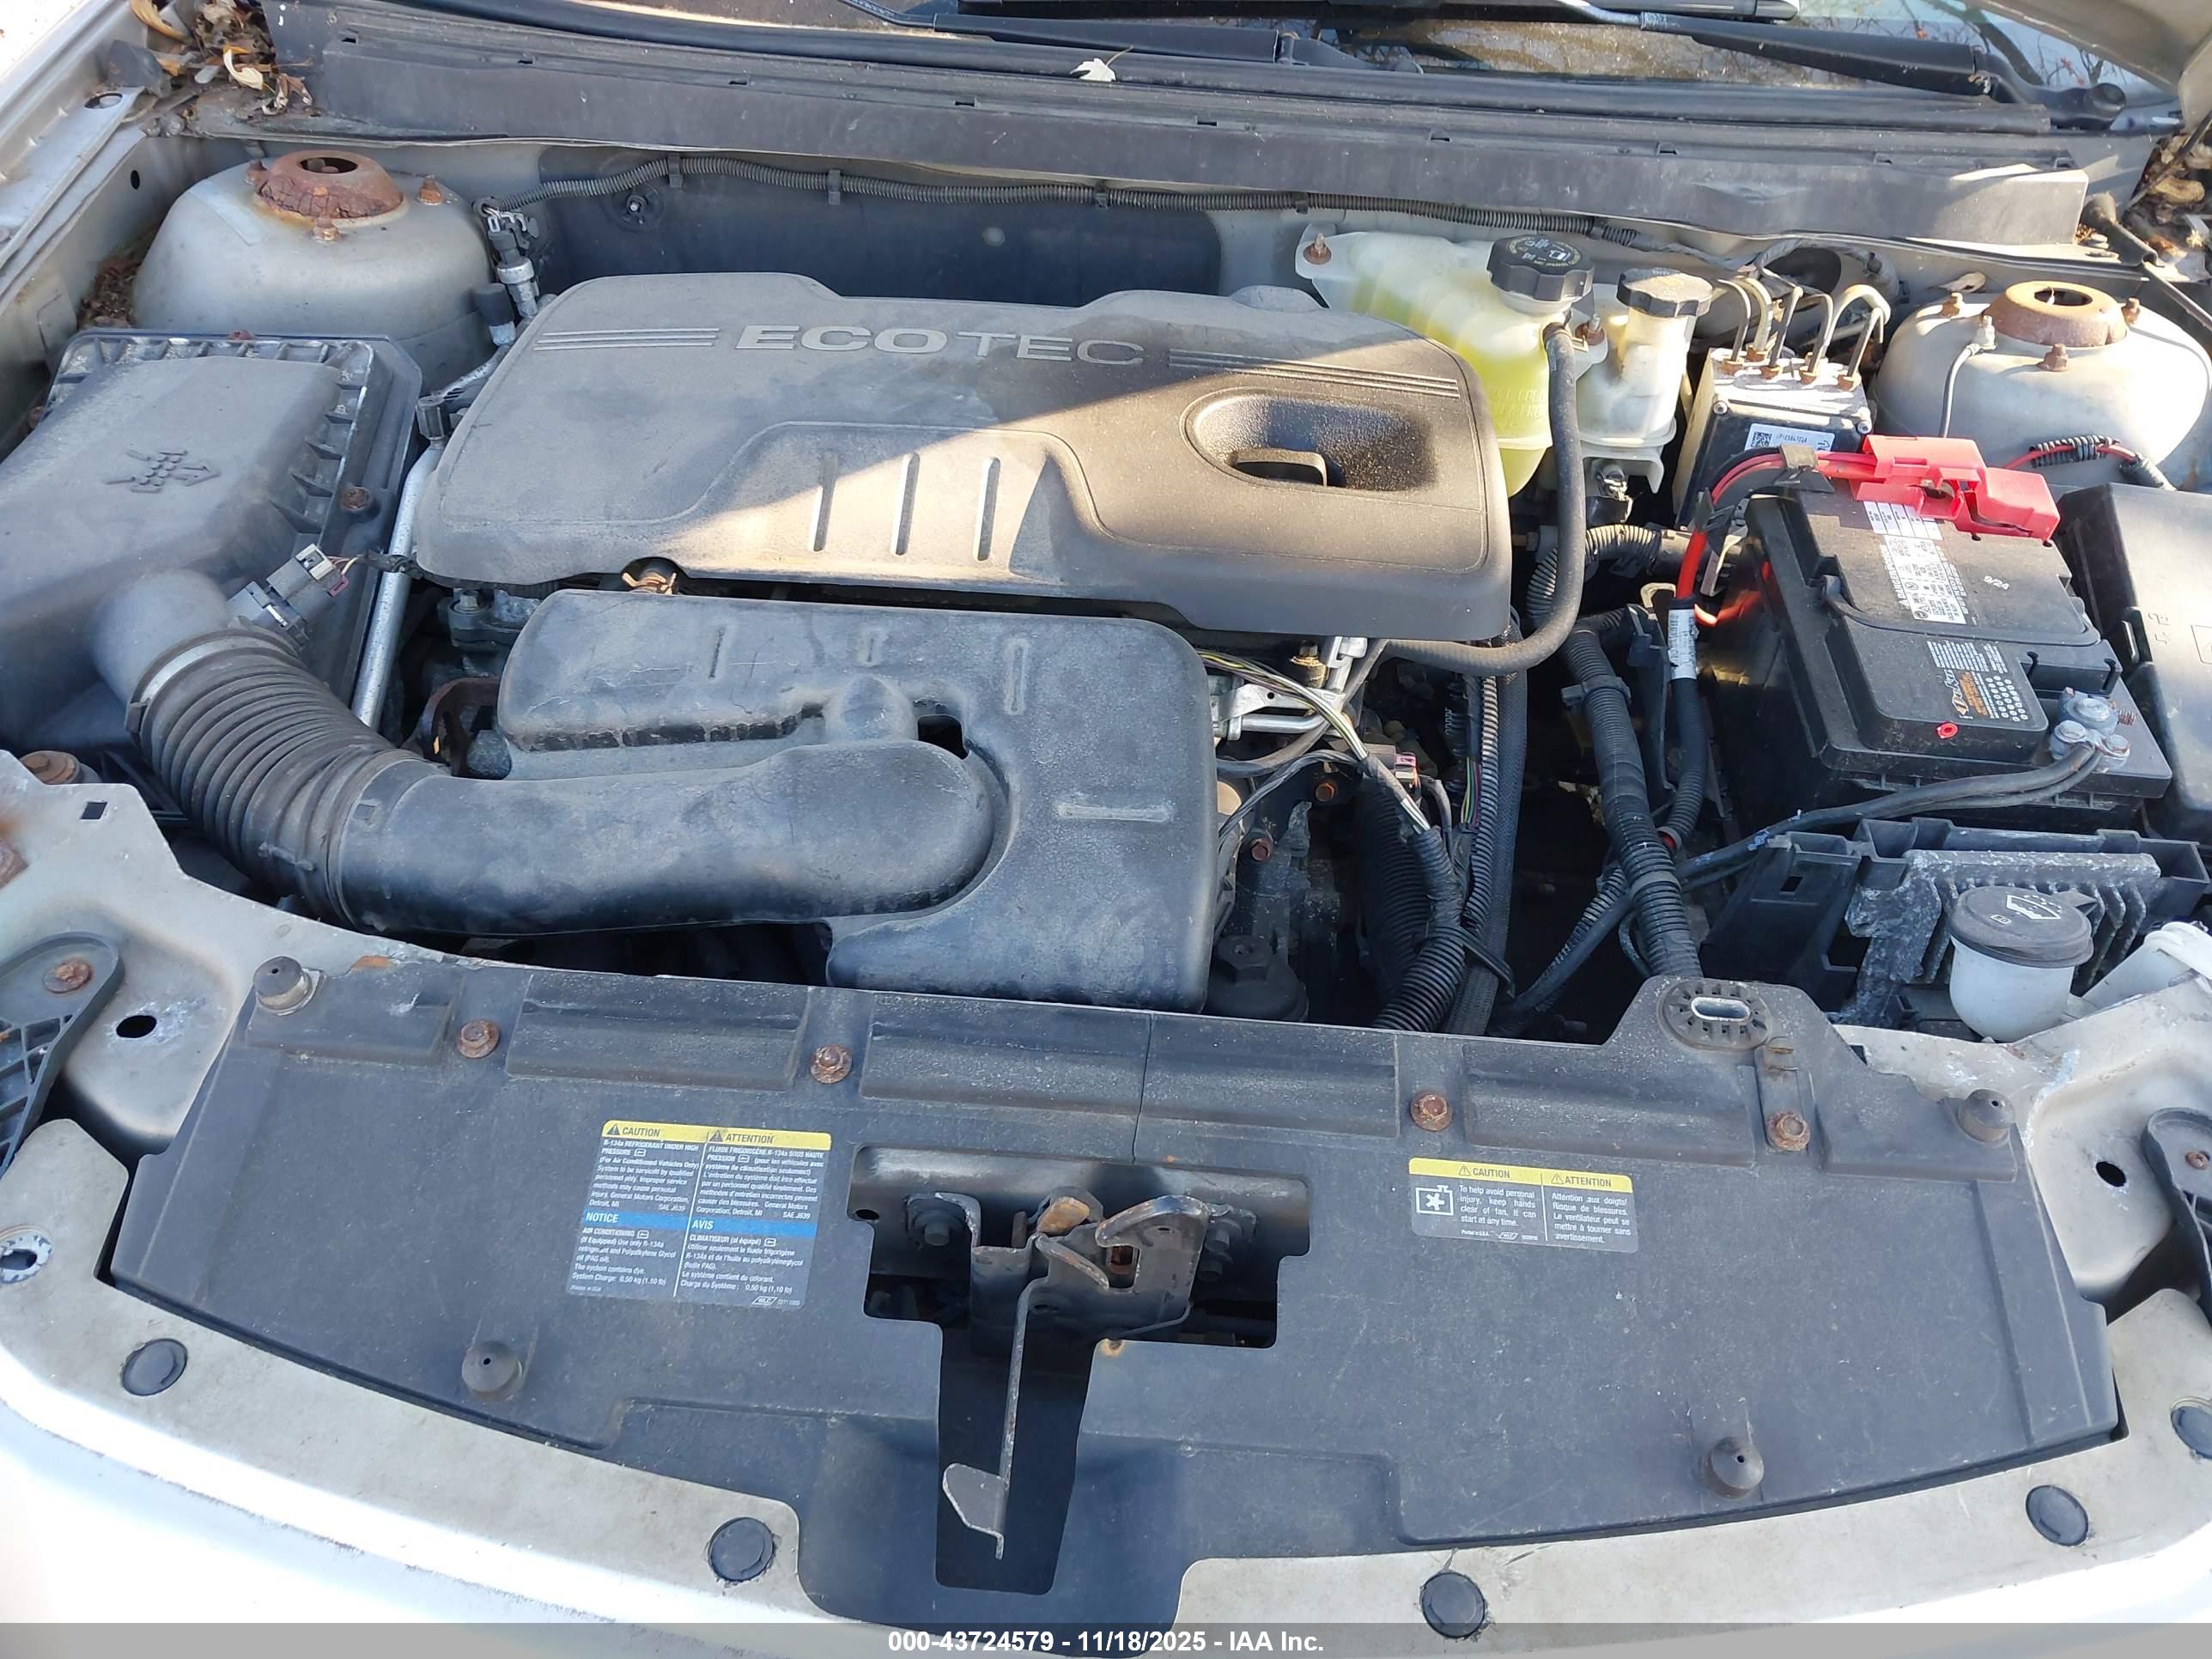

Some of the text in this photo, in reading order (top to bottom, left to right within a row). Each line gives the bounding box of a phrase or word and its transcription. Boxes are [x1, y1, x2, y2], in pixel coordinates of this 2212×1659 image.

[735, 325, 1144, 366] ECOTEC
[621, 1127, 660, 1137] CAUTION
[725, 1133, 775, 1144] ATTENTION
[1472, 1168, 1510, 1179] CAUTION
[1565, 1176, 1612, 1187] ATTENTION
[1459, 1185, 1534, 1199] To help avoid personal
[1459, 1194, 1535, 1209] injury, keep hands
[1552, 1192, 1627, 1206] Attention aux doigts!
[1460, 1205, 1536, 1218] clear of fan. It can
[1552, 1202, 1628, 1217] Risque de blessures.
[585, 1212, 619, 1223] NOTICE
[1461, 1214, 1518, 1227] start at any time.
[1553, 1212, 1630, 1226] Le ventilateur peut se
[691, 1219, 714, 1230] AVIS
[1553, 1222, 1577, 1232] mettre
[1587, 1224, 1612, 1235] tourner
[1614, 1227, 1631, 1237] sans
[1554, 1231, 1605, 1243] avertissement.
